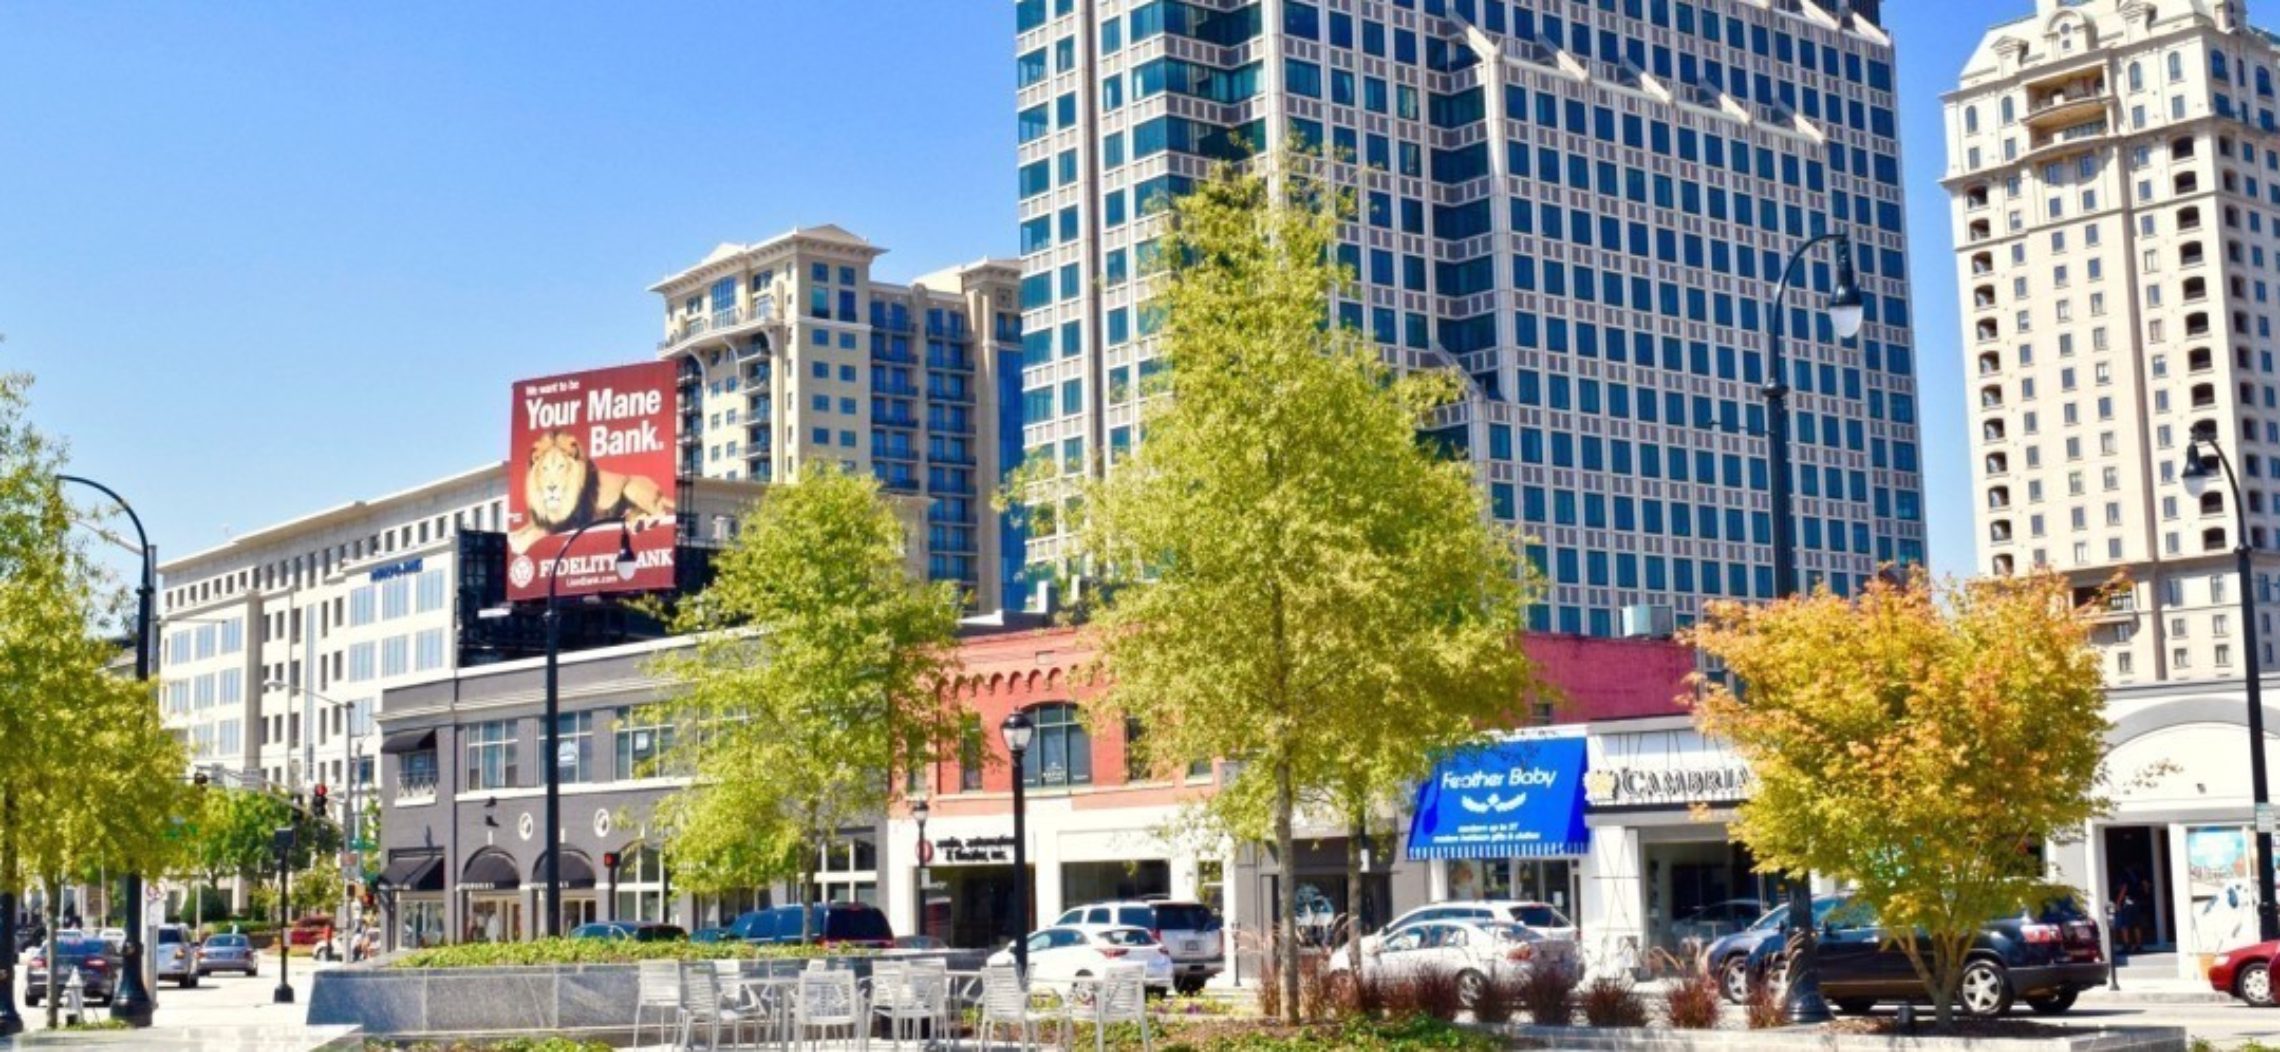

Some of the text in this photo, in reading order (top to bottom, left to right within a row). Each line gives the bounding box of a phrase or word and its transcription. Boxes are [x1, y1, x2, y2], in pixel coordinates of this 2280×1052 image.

[539, 383, 557, 393] want
[559, 382, 567, 391] to
[568, 381, 580, 390] be
[526, 388, 662, 430] Your Mane
[590, 420, 664, 457] Bank.
[1442, 767, 1557, 789] Feather Baby
[1622, 767, 1749, 796] CAMBRIA
